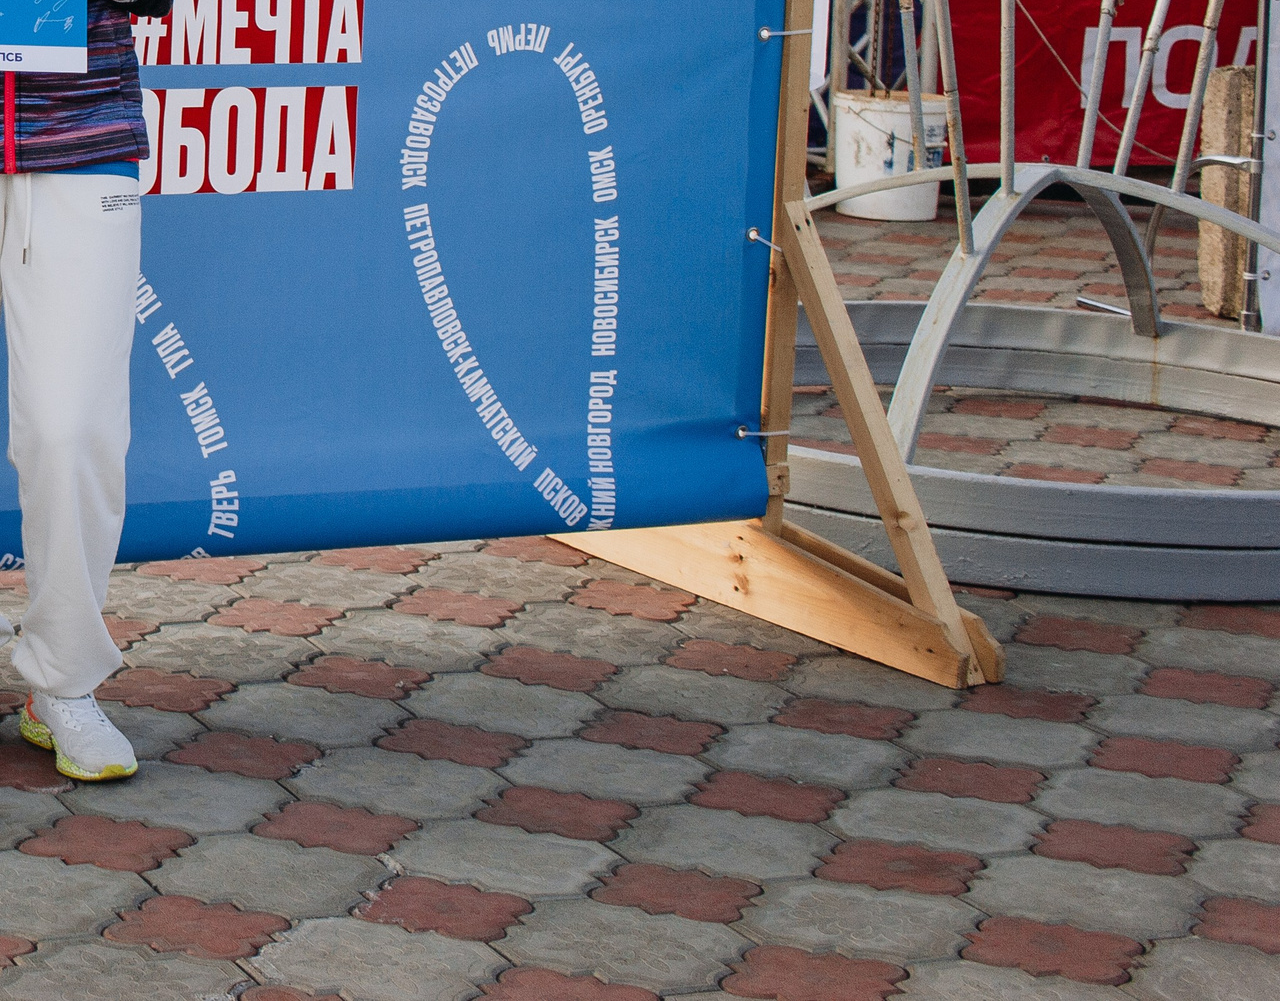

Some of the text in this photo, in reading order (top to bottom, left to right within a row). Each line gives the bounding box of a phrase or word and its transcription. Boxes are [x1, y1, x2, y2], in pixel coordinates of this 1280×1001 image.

[399, 23, 620, 530] ЖНИЙ НОВГОРОД НОВОСИБИРСК ОМСК ОРЕНБУРГ ПЕРМЬ ПЕТРОЗАВОДСК ПЕТРОПАВЛОВСК-КАМЧАТСКИЙ ПСКОВ
[151, 322, 194, 379] ТУЛА
[179, 381, 228, 458] ТОМСК
[208, 469, 239, 539] ТВЕРЬ
